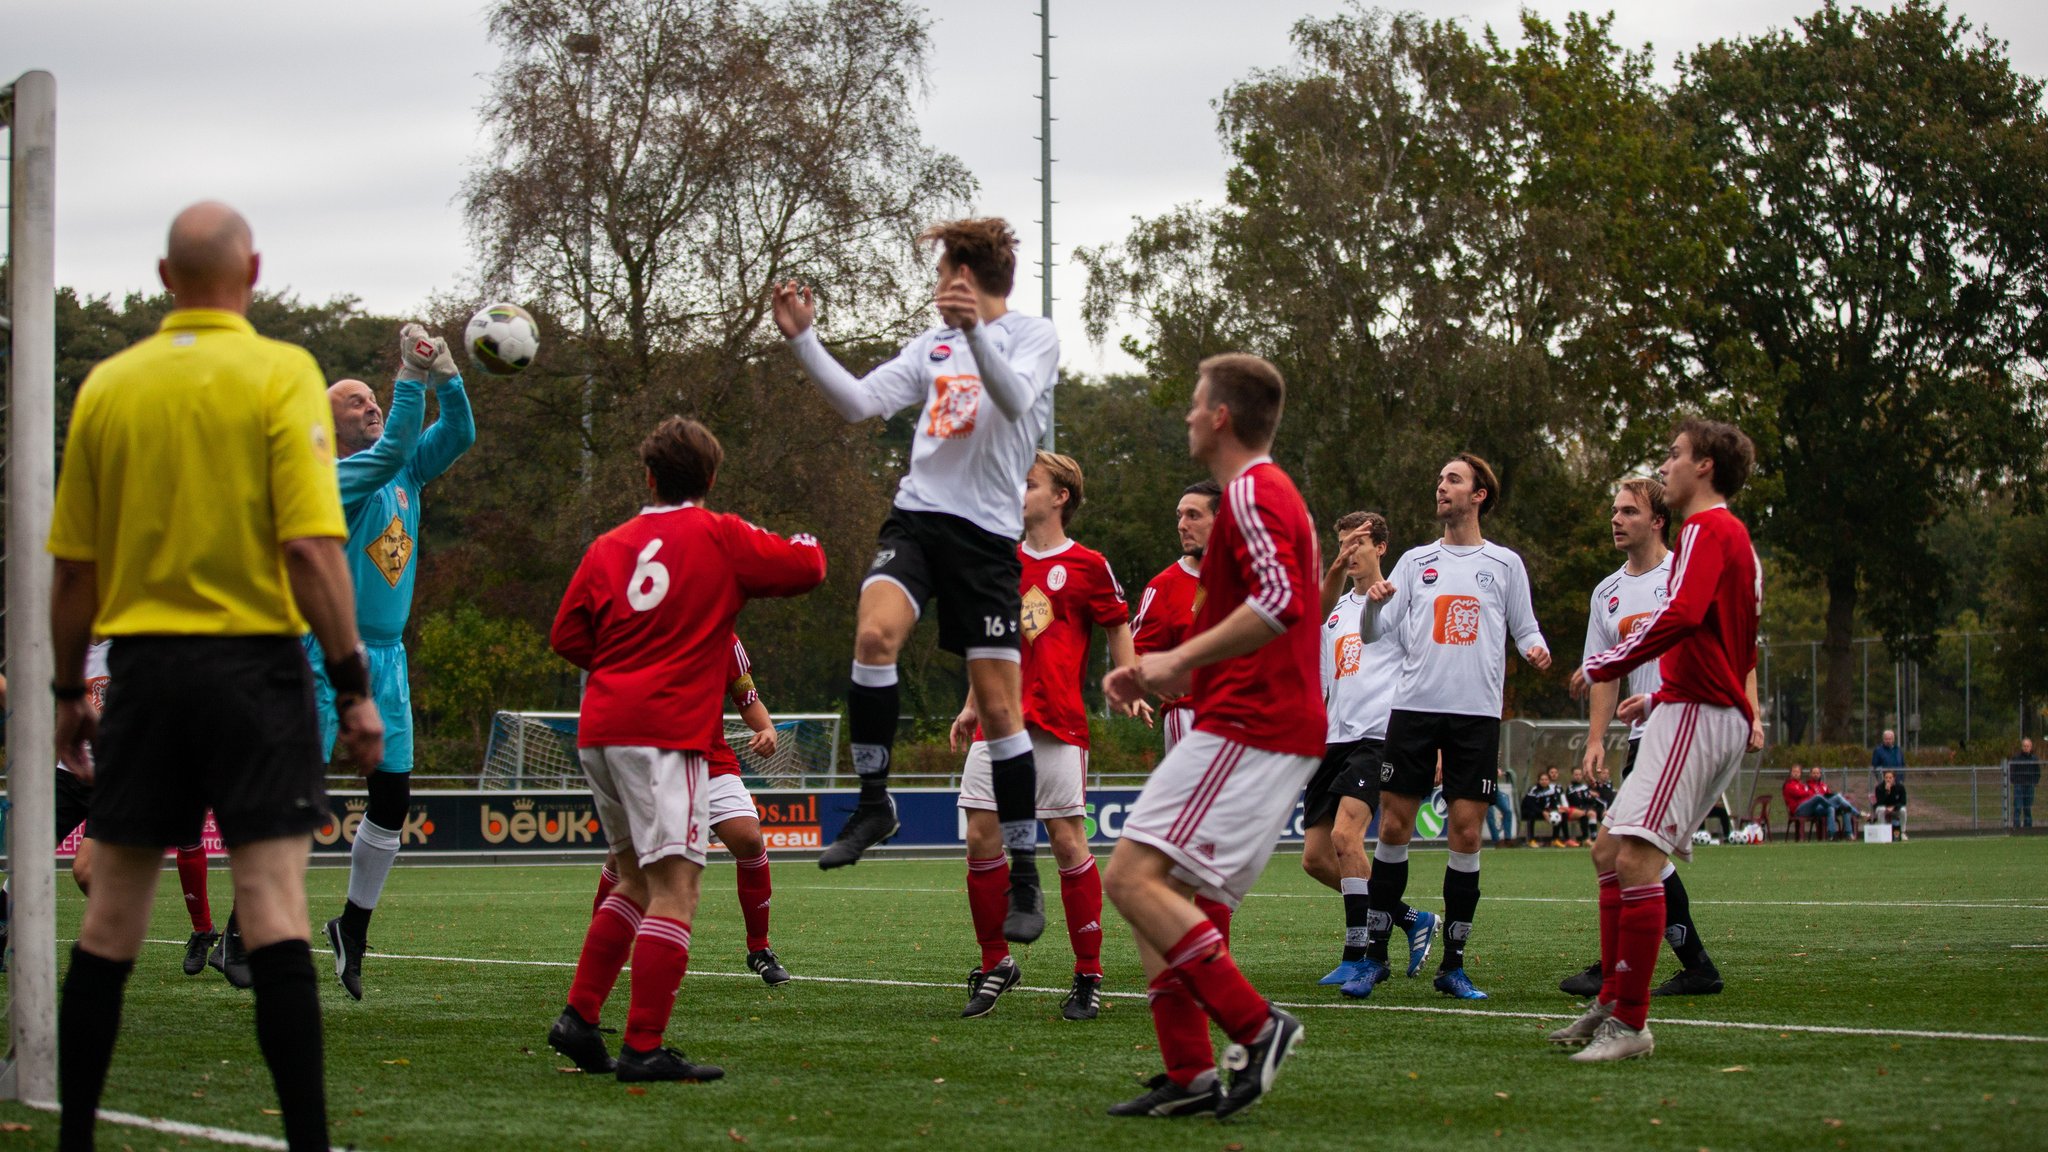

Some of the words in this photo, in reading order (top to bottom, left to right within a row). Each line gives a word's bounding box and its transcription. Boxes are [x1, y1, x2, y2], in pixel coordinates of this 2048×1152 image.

[626, 538, 670, 611] 6
[984, 616, 1005, 637] 16
[1482, 778, 1492, 795] 11
[690, 823, 698, 843] 6
